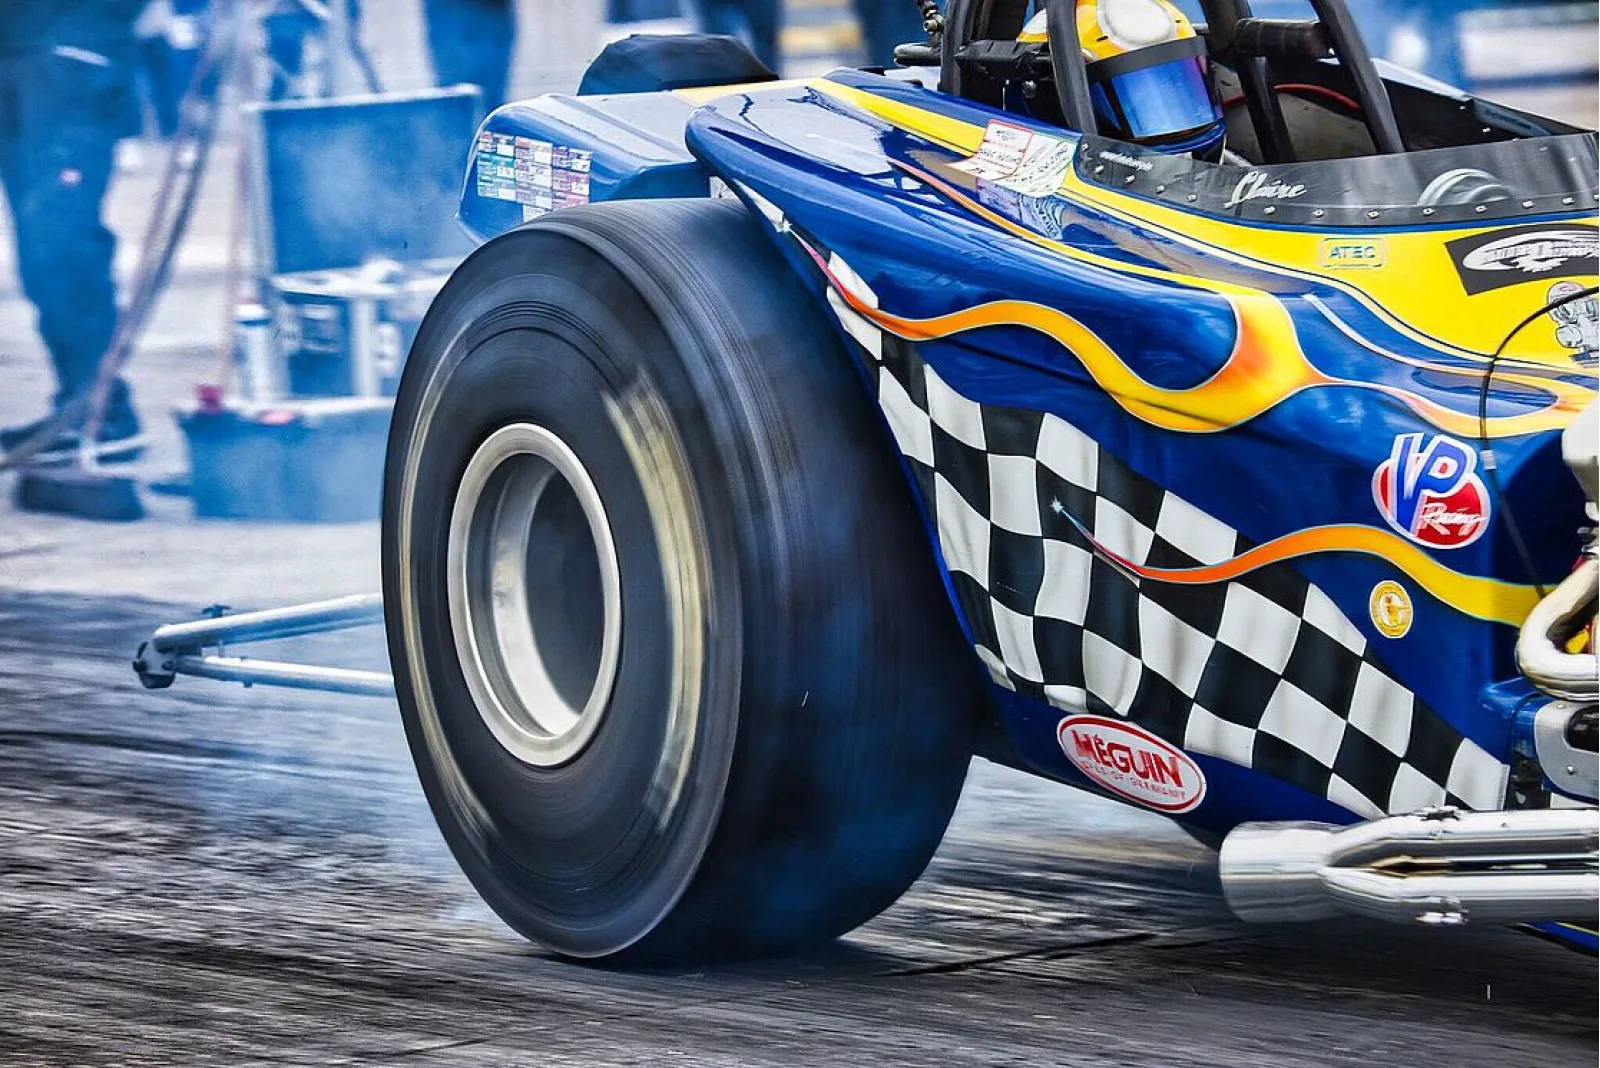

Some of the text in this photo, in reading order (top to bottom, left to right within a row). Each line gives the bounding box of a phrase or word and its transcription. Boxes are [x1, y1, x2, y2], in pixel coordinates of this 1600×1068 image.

[1223, 171, 1307, 208] Claire
[1329, 246, 1376, 259] ATEC
[1392, 434, 1476, 536] VP
